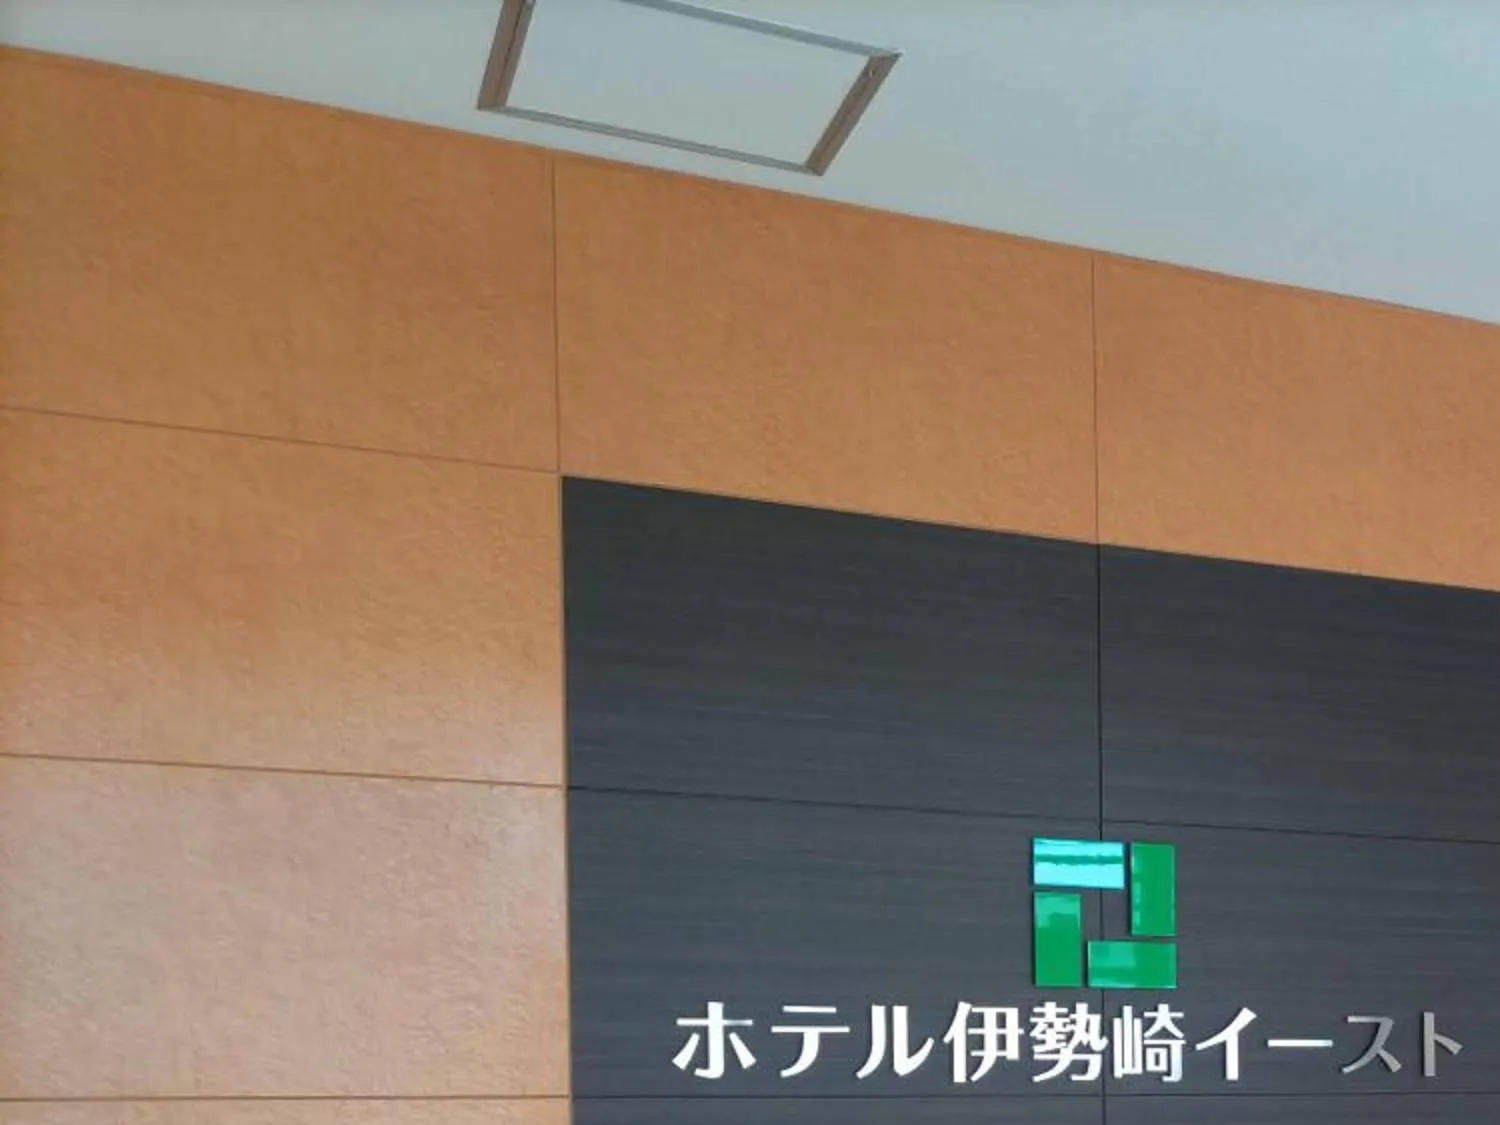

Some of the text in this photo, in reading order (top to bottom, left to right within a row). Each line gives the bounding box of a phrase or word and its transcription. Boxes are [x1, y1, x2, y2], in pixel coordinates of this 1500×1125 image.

[671, 1000, 1464, 1083] ホテル伊勢崎イースト
